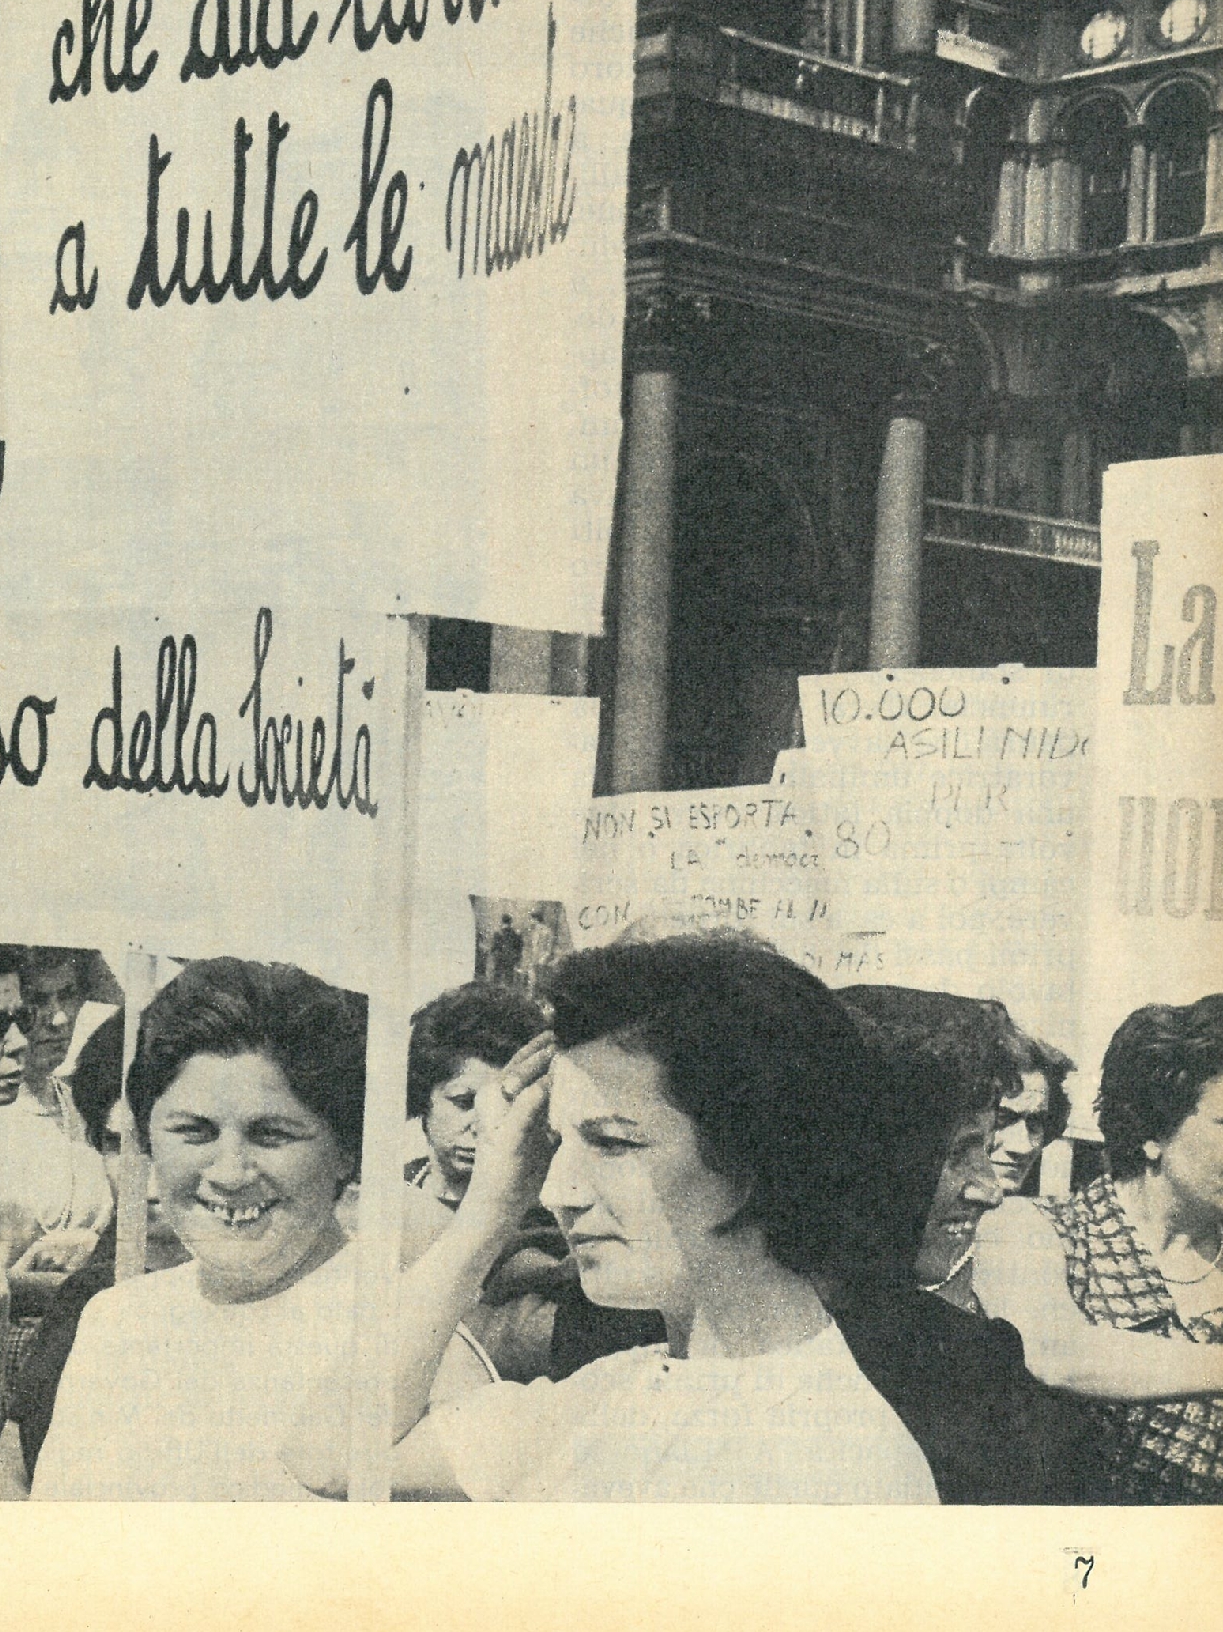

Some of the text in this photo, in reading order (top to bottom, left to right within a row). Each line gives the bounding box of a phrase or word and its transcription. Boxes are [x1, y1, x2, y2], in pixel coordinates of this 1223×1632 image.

[49, 220, 99, 315] a
[126, 110, 329, 311] tutte
[343, 77, 414, 296] le
[1122, 539, 1218, 707] La
[82, 633, 230, 799] della
[236, 606, 378, 819] Società
[821, 685, 966, 725] 10.000
[884, 725, 985, 760] ASILI
[582, 799, 797, 845] NON SI ESPORTA
[835, 819, 891, 859] 80
[670, 850, 705, 870] LA
[578, 900, 631, 931] CON
[1074, 1555, 1094, 1589] 7
